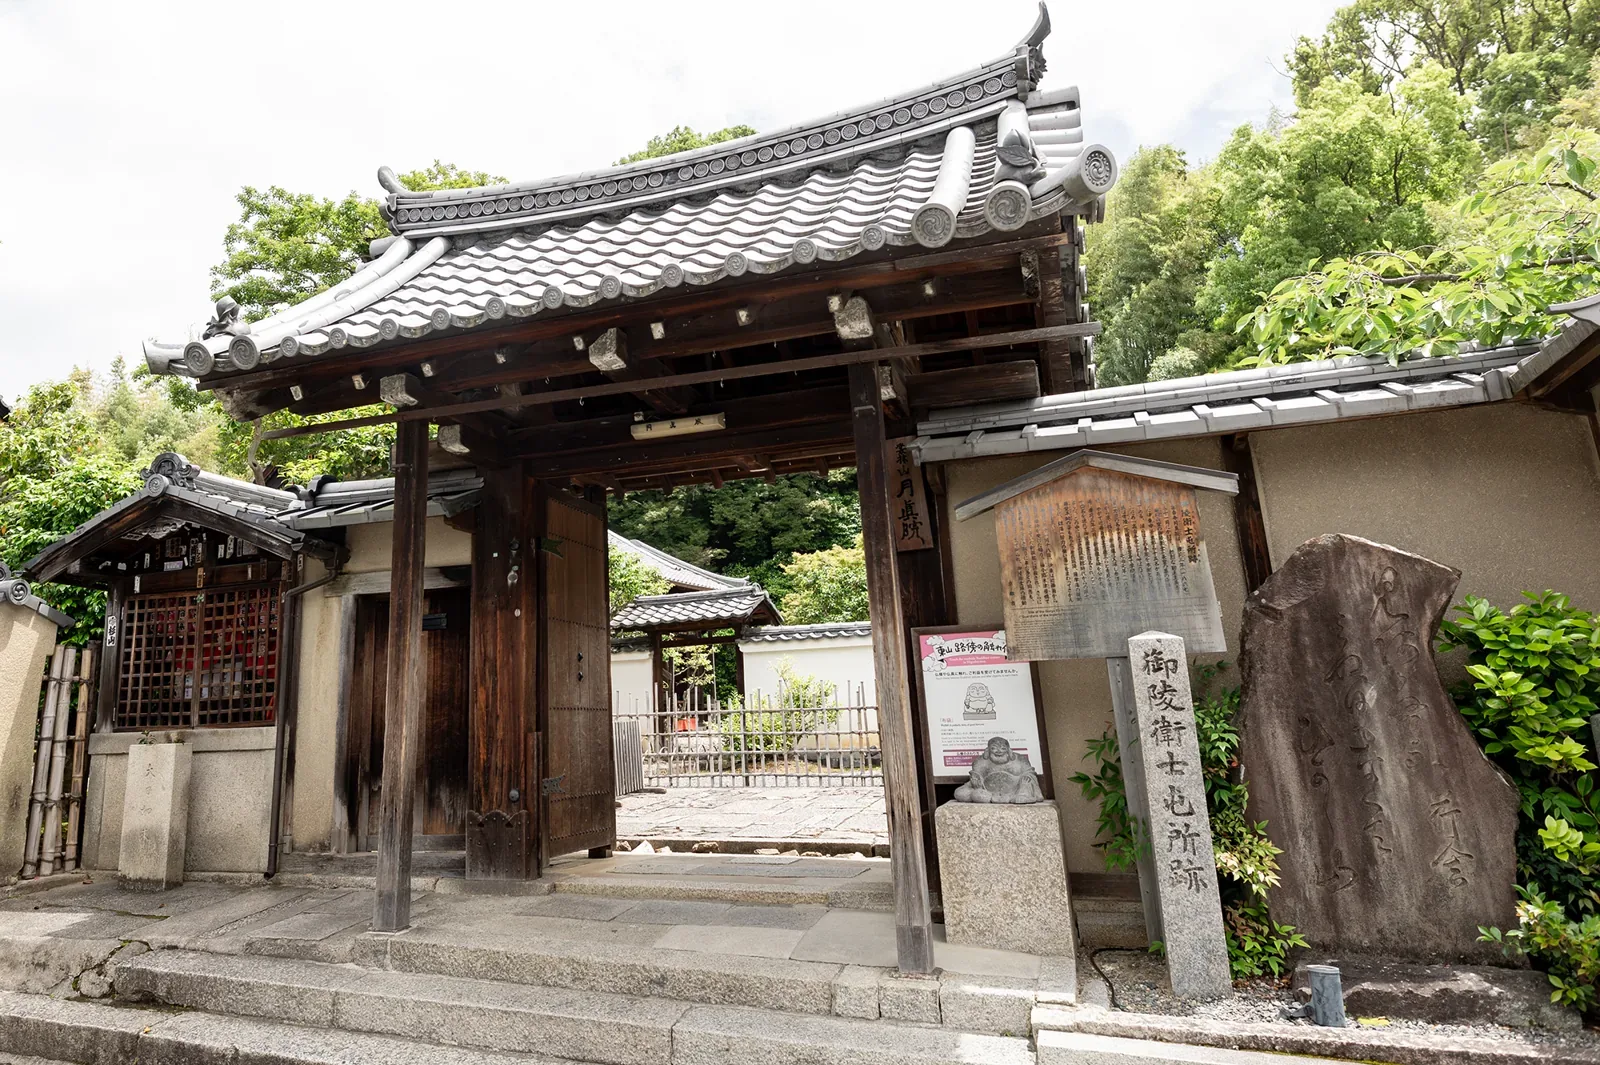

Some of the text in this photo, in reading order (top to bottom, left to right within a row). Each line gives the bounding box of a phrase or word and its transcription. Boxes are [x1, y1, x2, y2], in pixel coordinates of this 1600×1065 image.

[936, 645, 953, 657] 東山
[1141, 648, 1209, 894] 御陵衛士屯所跡
